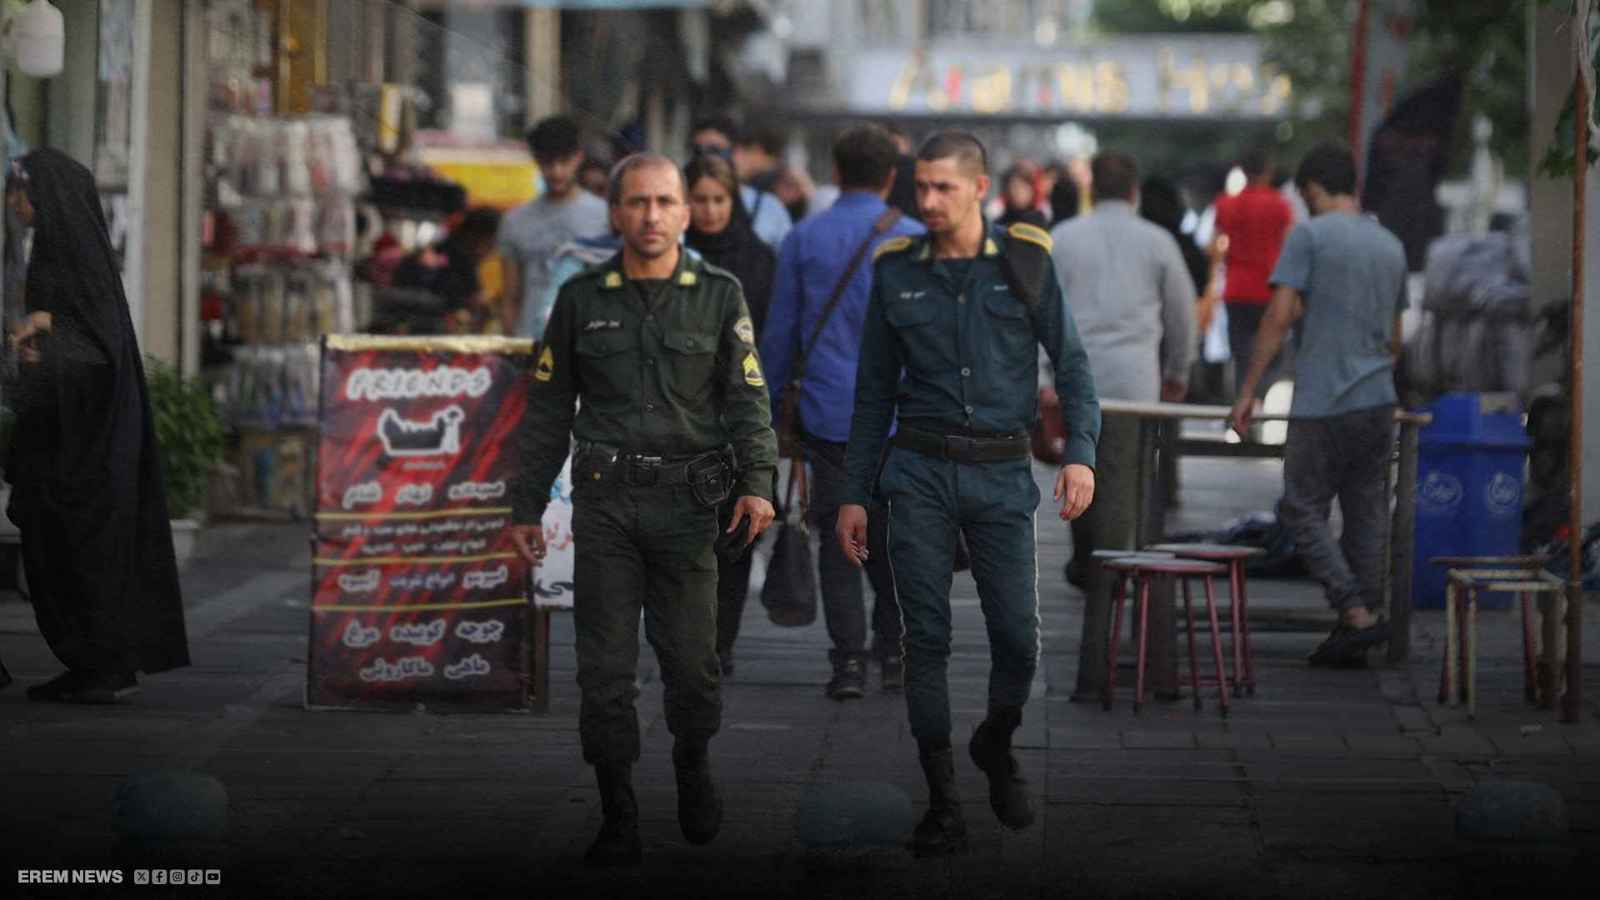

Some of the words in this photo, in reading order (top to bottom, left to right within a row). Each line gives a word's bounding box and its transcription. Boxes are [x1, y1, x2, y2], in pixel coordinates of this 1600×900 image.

[348, 365, 491, 401] FRIENDS
[389, 618, 446, 646] کوبیده
[456, 619, 504, 643] جوجه
[444, 653, 490, 679] ماهی
